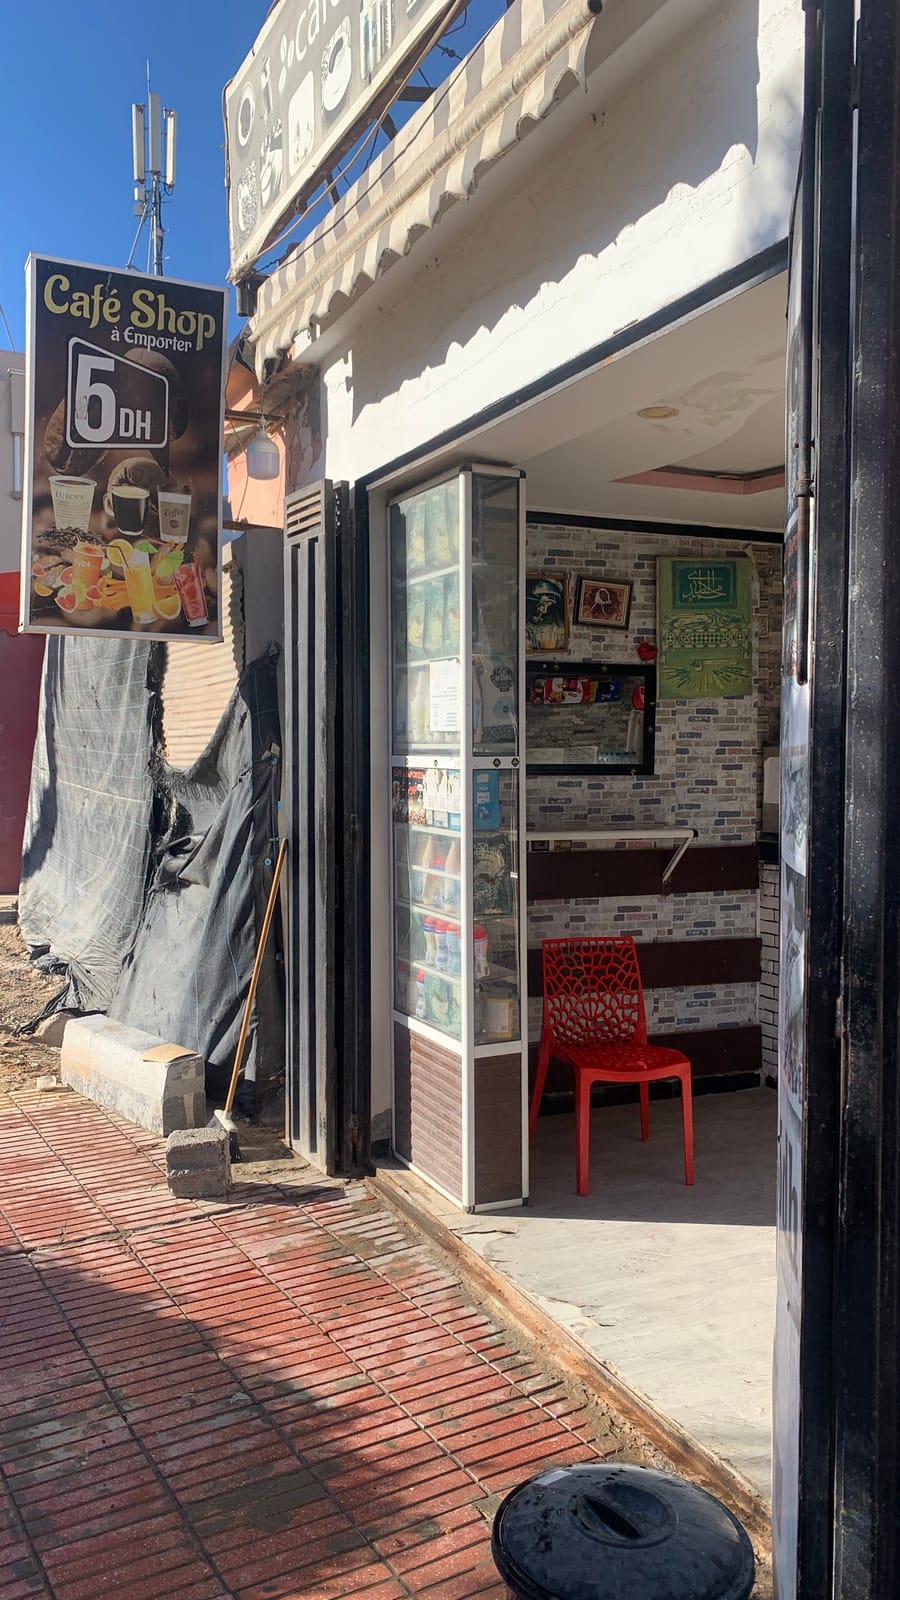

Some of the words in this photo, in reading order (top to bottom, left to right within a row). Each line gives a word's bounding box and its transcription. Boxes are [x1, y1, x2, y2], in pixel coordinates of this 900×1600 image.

[43, 274, 121, 328] Café
[130, 289, 216, 350] Shop
[110, 326, 120, 342] à
[124, 326, 192, 352] Emporter
[119, 407, 151, 439] DH
